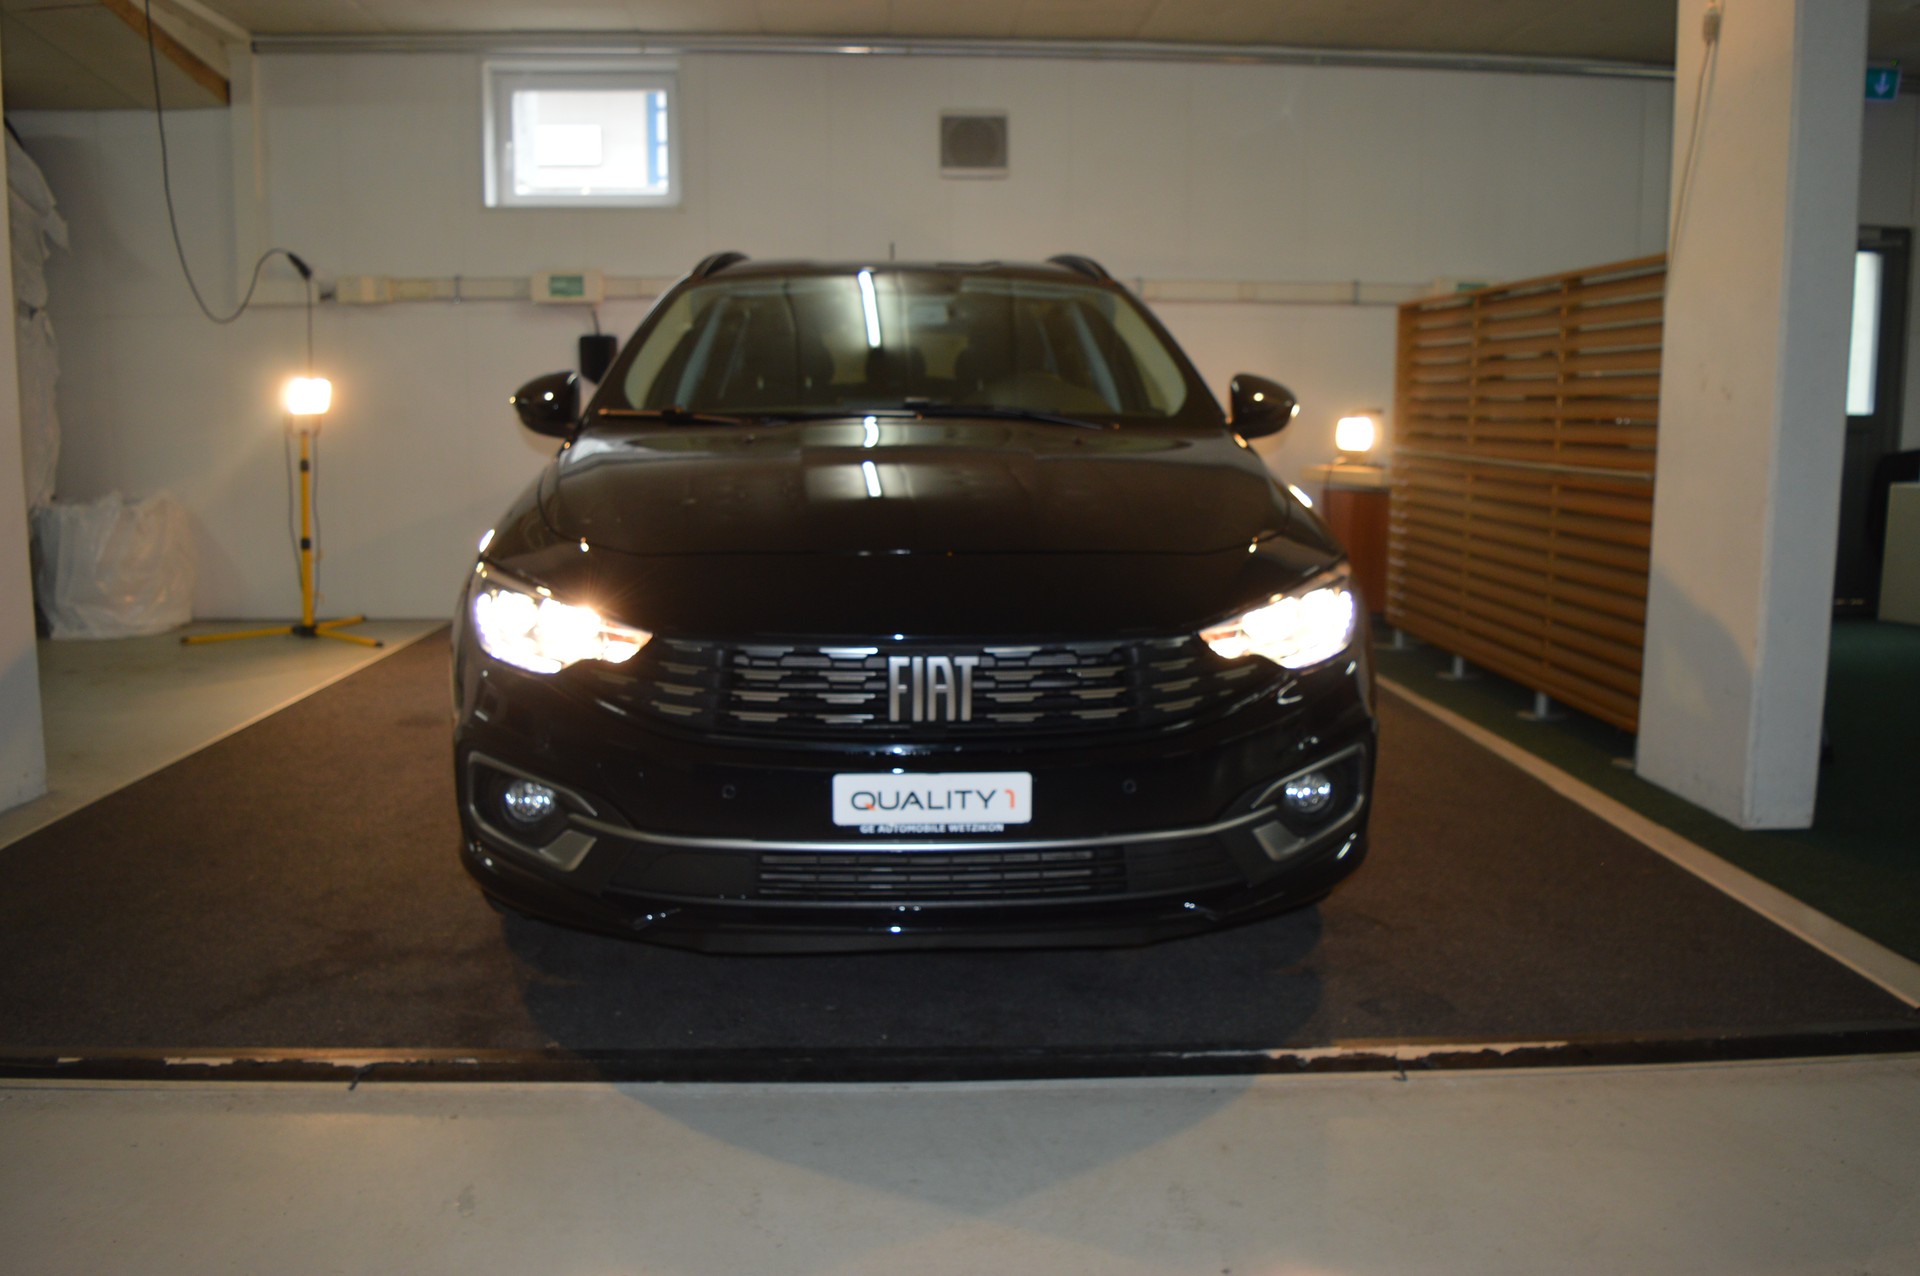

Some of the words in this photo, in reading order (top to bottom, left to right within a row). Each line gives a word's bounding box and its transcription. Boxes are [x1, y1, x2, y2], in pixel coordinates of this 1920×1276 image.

[889, 656, 979, 721] FIAT
[851, 790, 997, 811] QUALITY
[1005, 789, 1016, 809] 1
[877, 823, 947, 834] AUTOMOBILE
